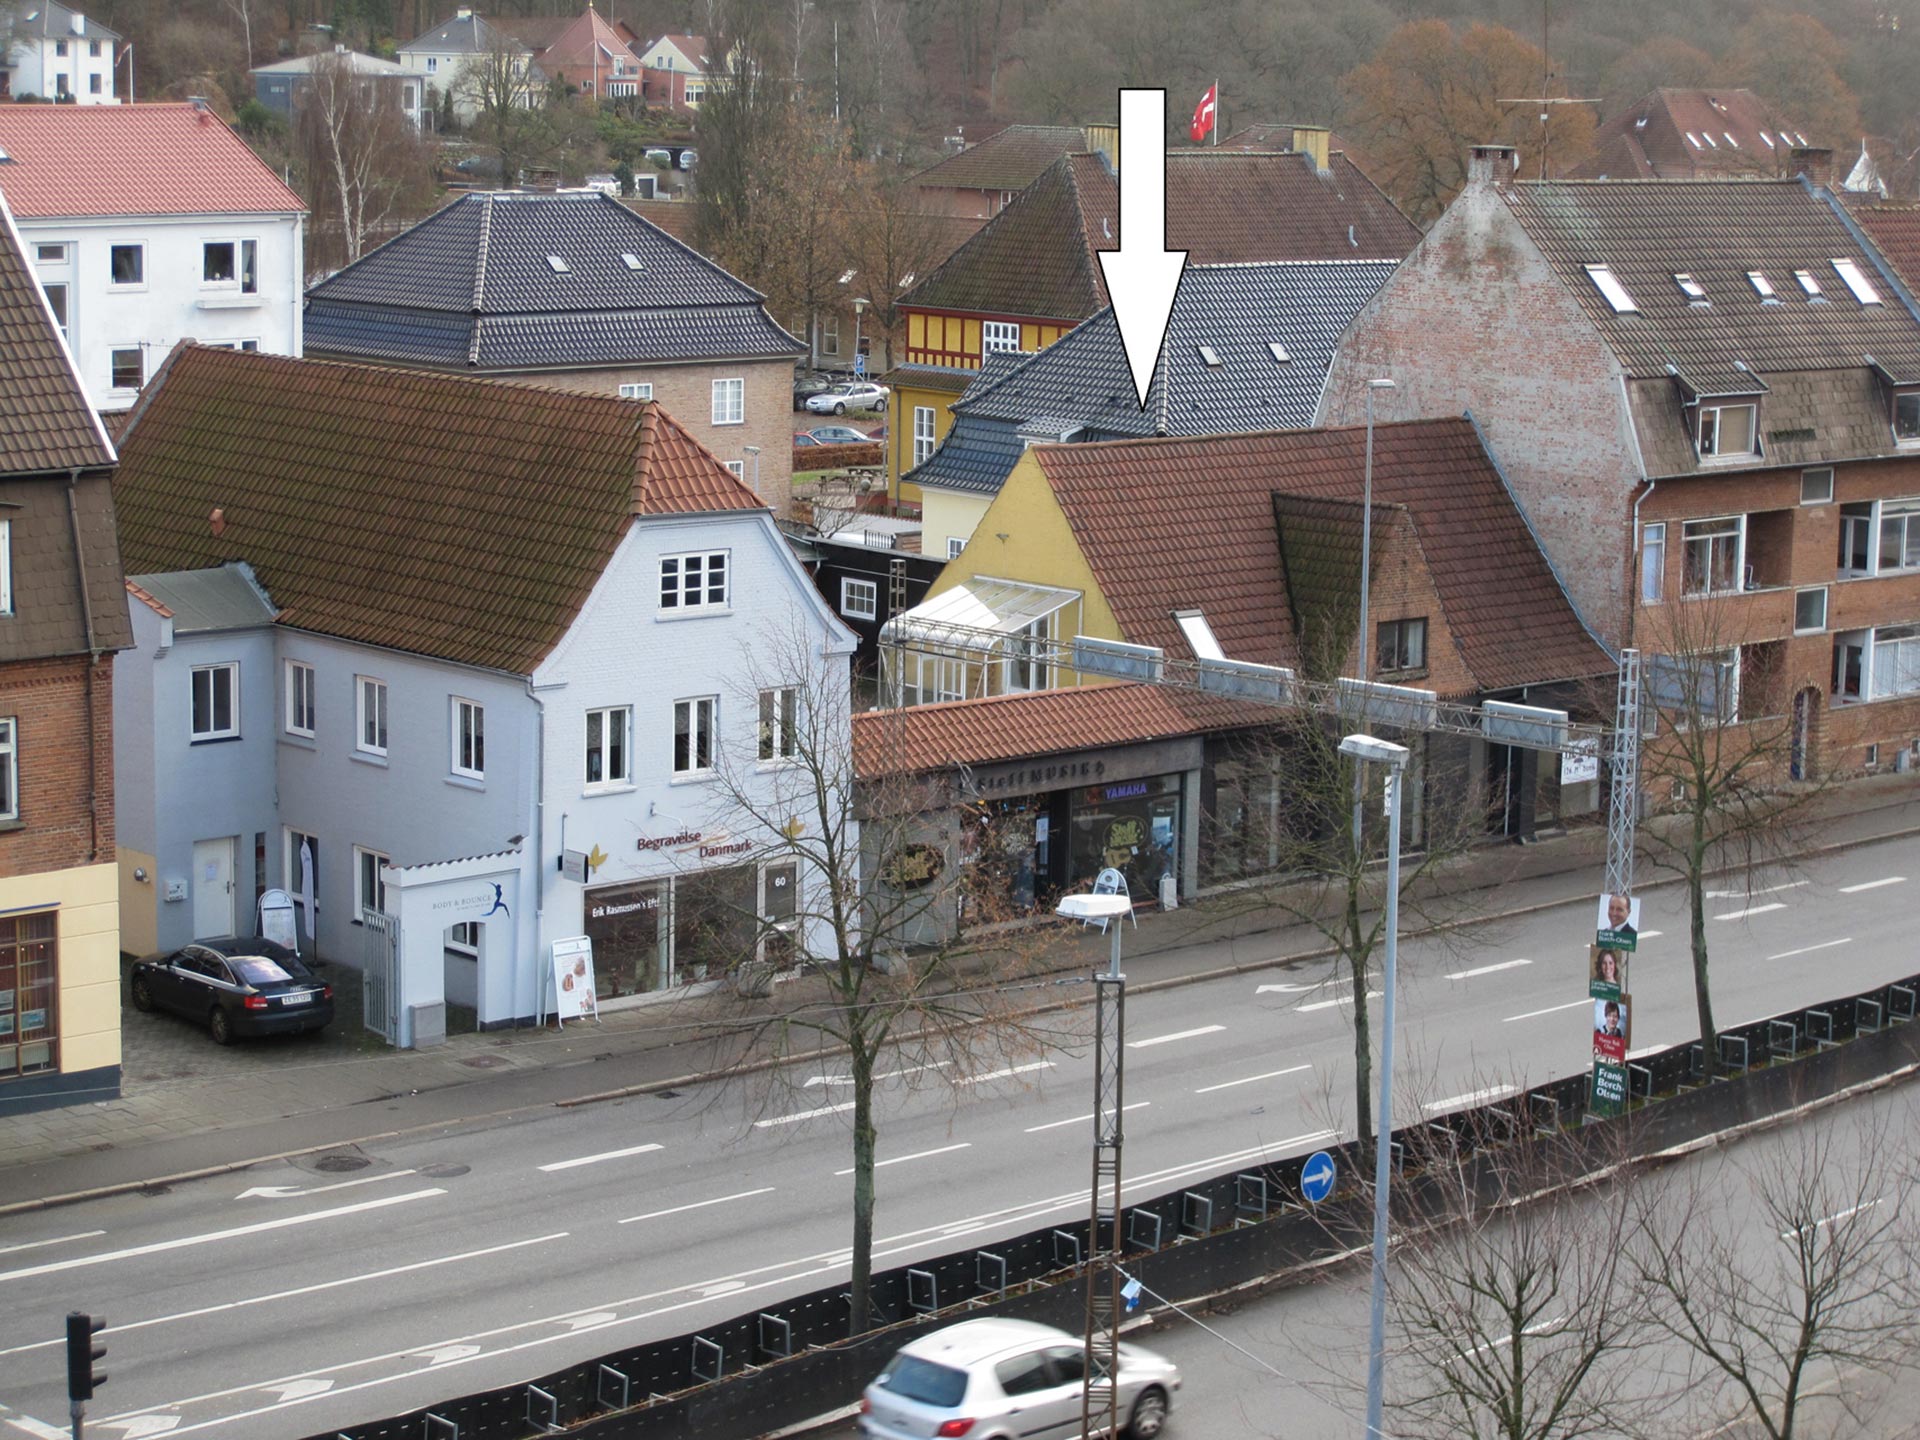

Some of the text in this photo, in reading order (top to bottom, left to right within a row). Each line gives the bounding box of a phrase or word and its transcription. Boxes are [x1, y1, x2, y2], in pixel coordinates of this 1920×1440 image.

[1106, 783, 1147, 800] YAMAHA
[637, 829, 702, 851] Begravelse
[699, 838, 752, 859] Danmark
[775, 877, 785, 887] 60
[432, 901, 452, 910] BODY
[461, 895, 492, 905] BOUNCE
[592, 906, 605, 918] Erik
[606, 901, 646, 916] Rasmussen's
[1598, 1067, 1623, 1082] Frank
[1597, 1077, 1625, 1093] Borch-
[1596, 1087, 1621, 1101] Olsen
